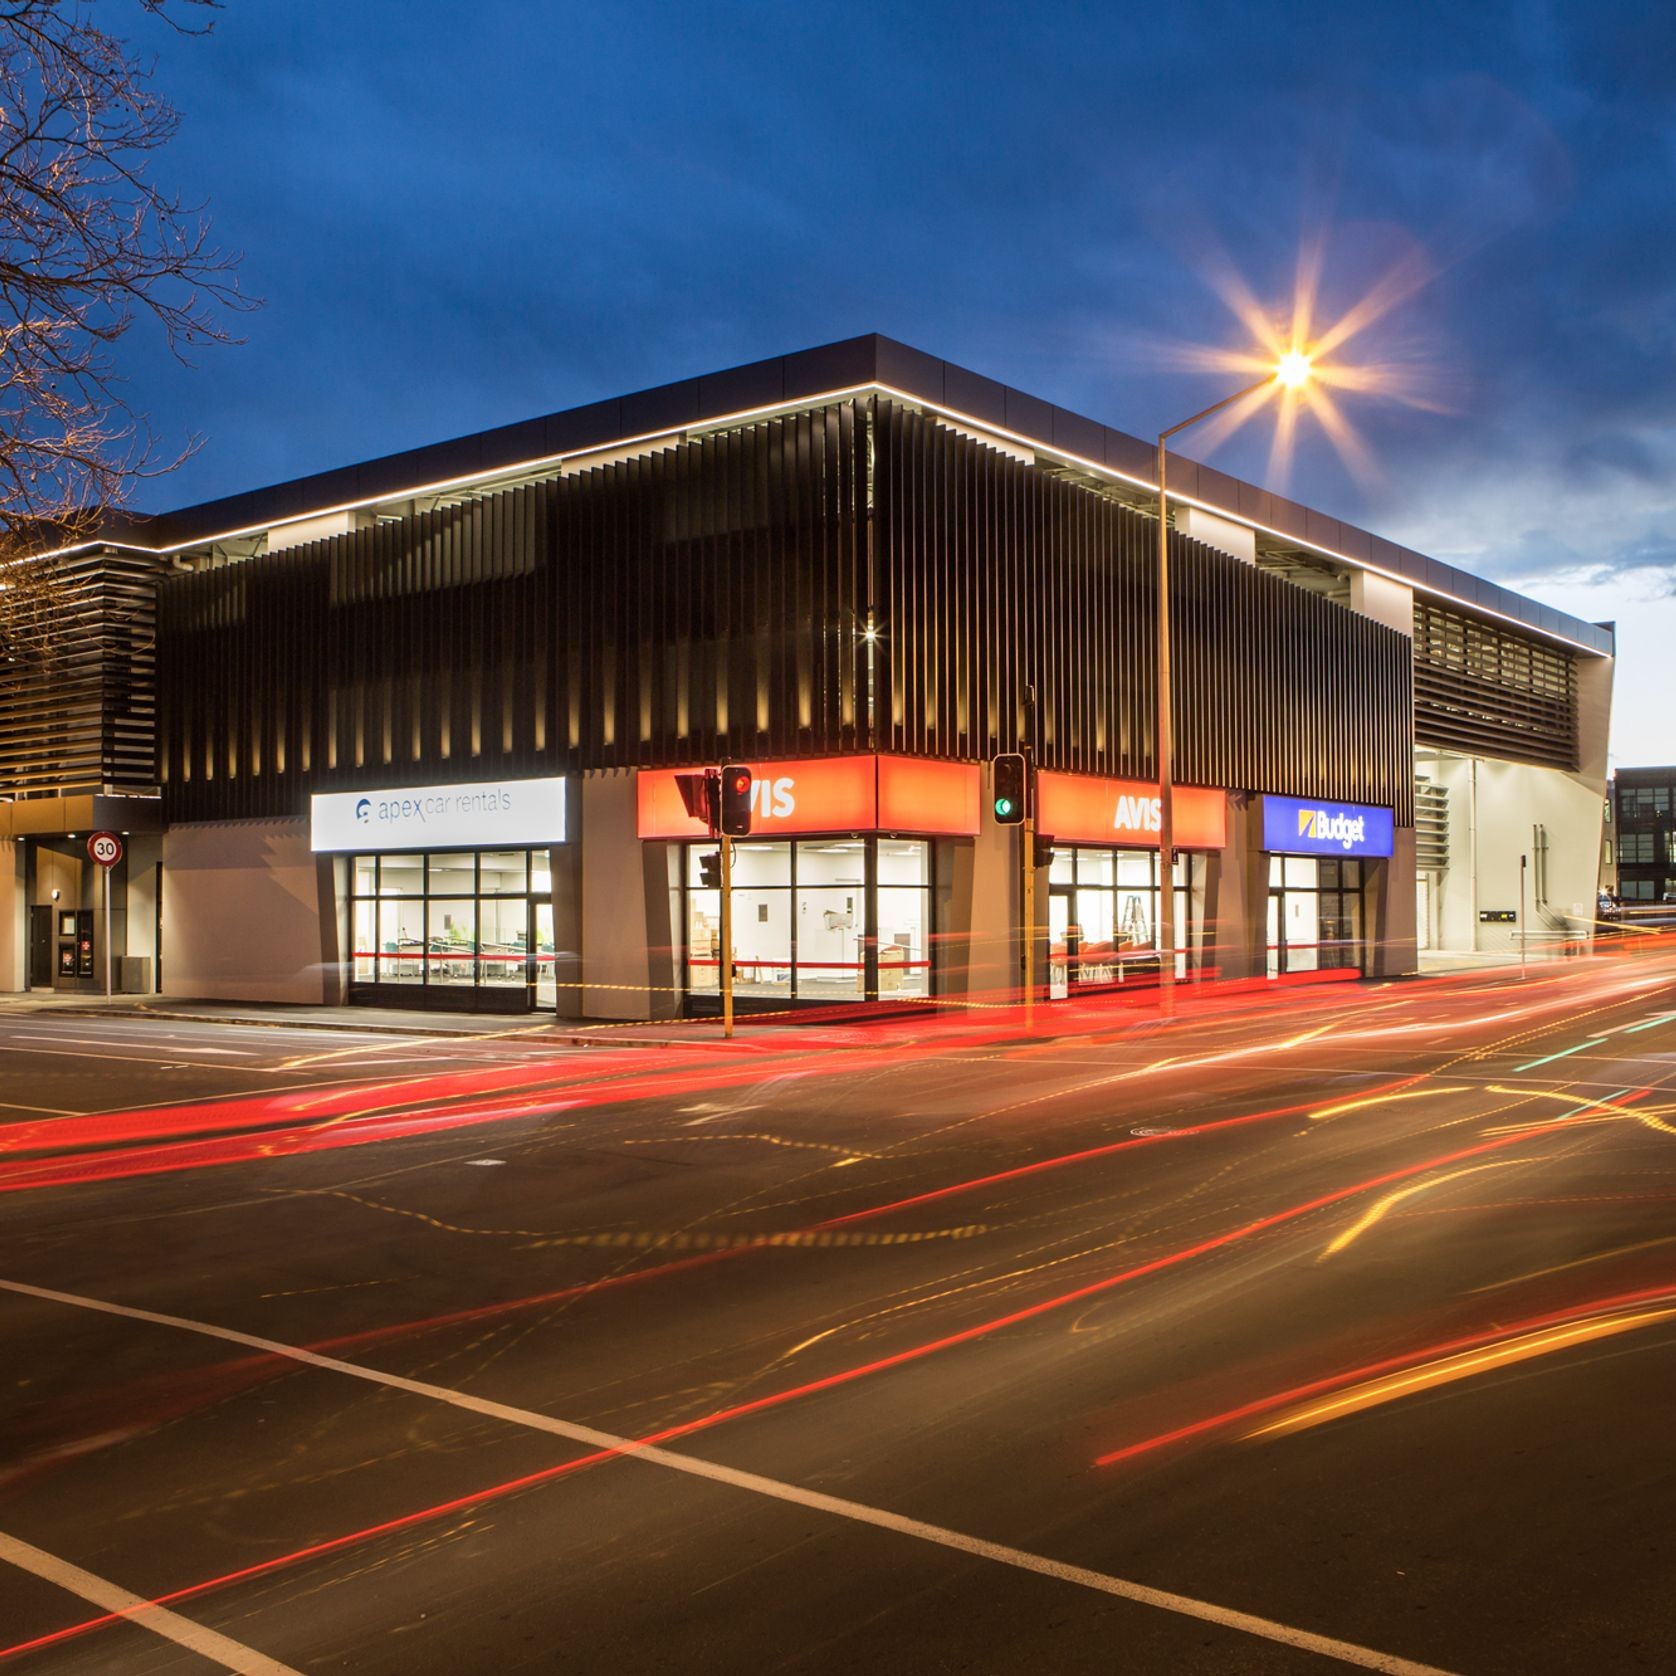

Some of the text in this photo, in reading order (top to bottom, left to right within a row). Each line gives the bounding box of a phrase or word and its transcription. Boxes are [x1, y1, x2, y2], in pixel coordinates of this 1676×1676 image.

[378, 788, 511, 823] apex car rentals
[750, 777, 795, 818] IS
[1114, 795, 1161, 832] AVIS
[97, 842, 114, 855] 30
[1317, 810, 1365, 850] Budget
